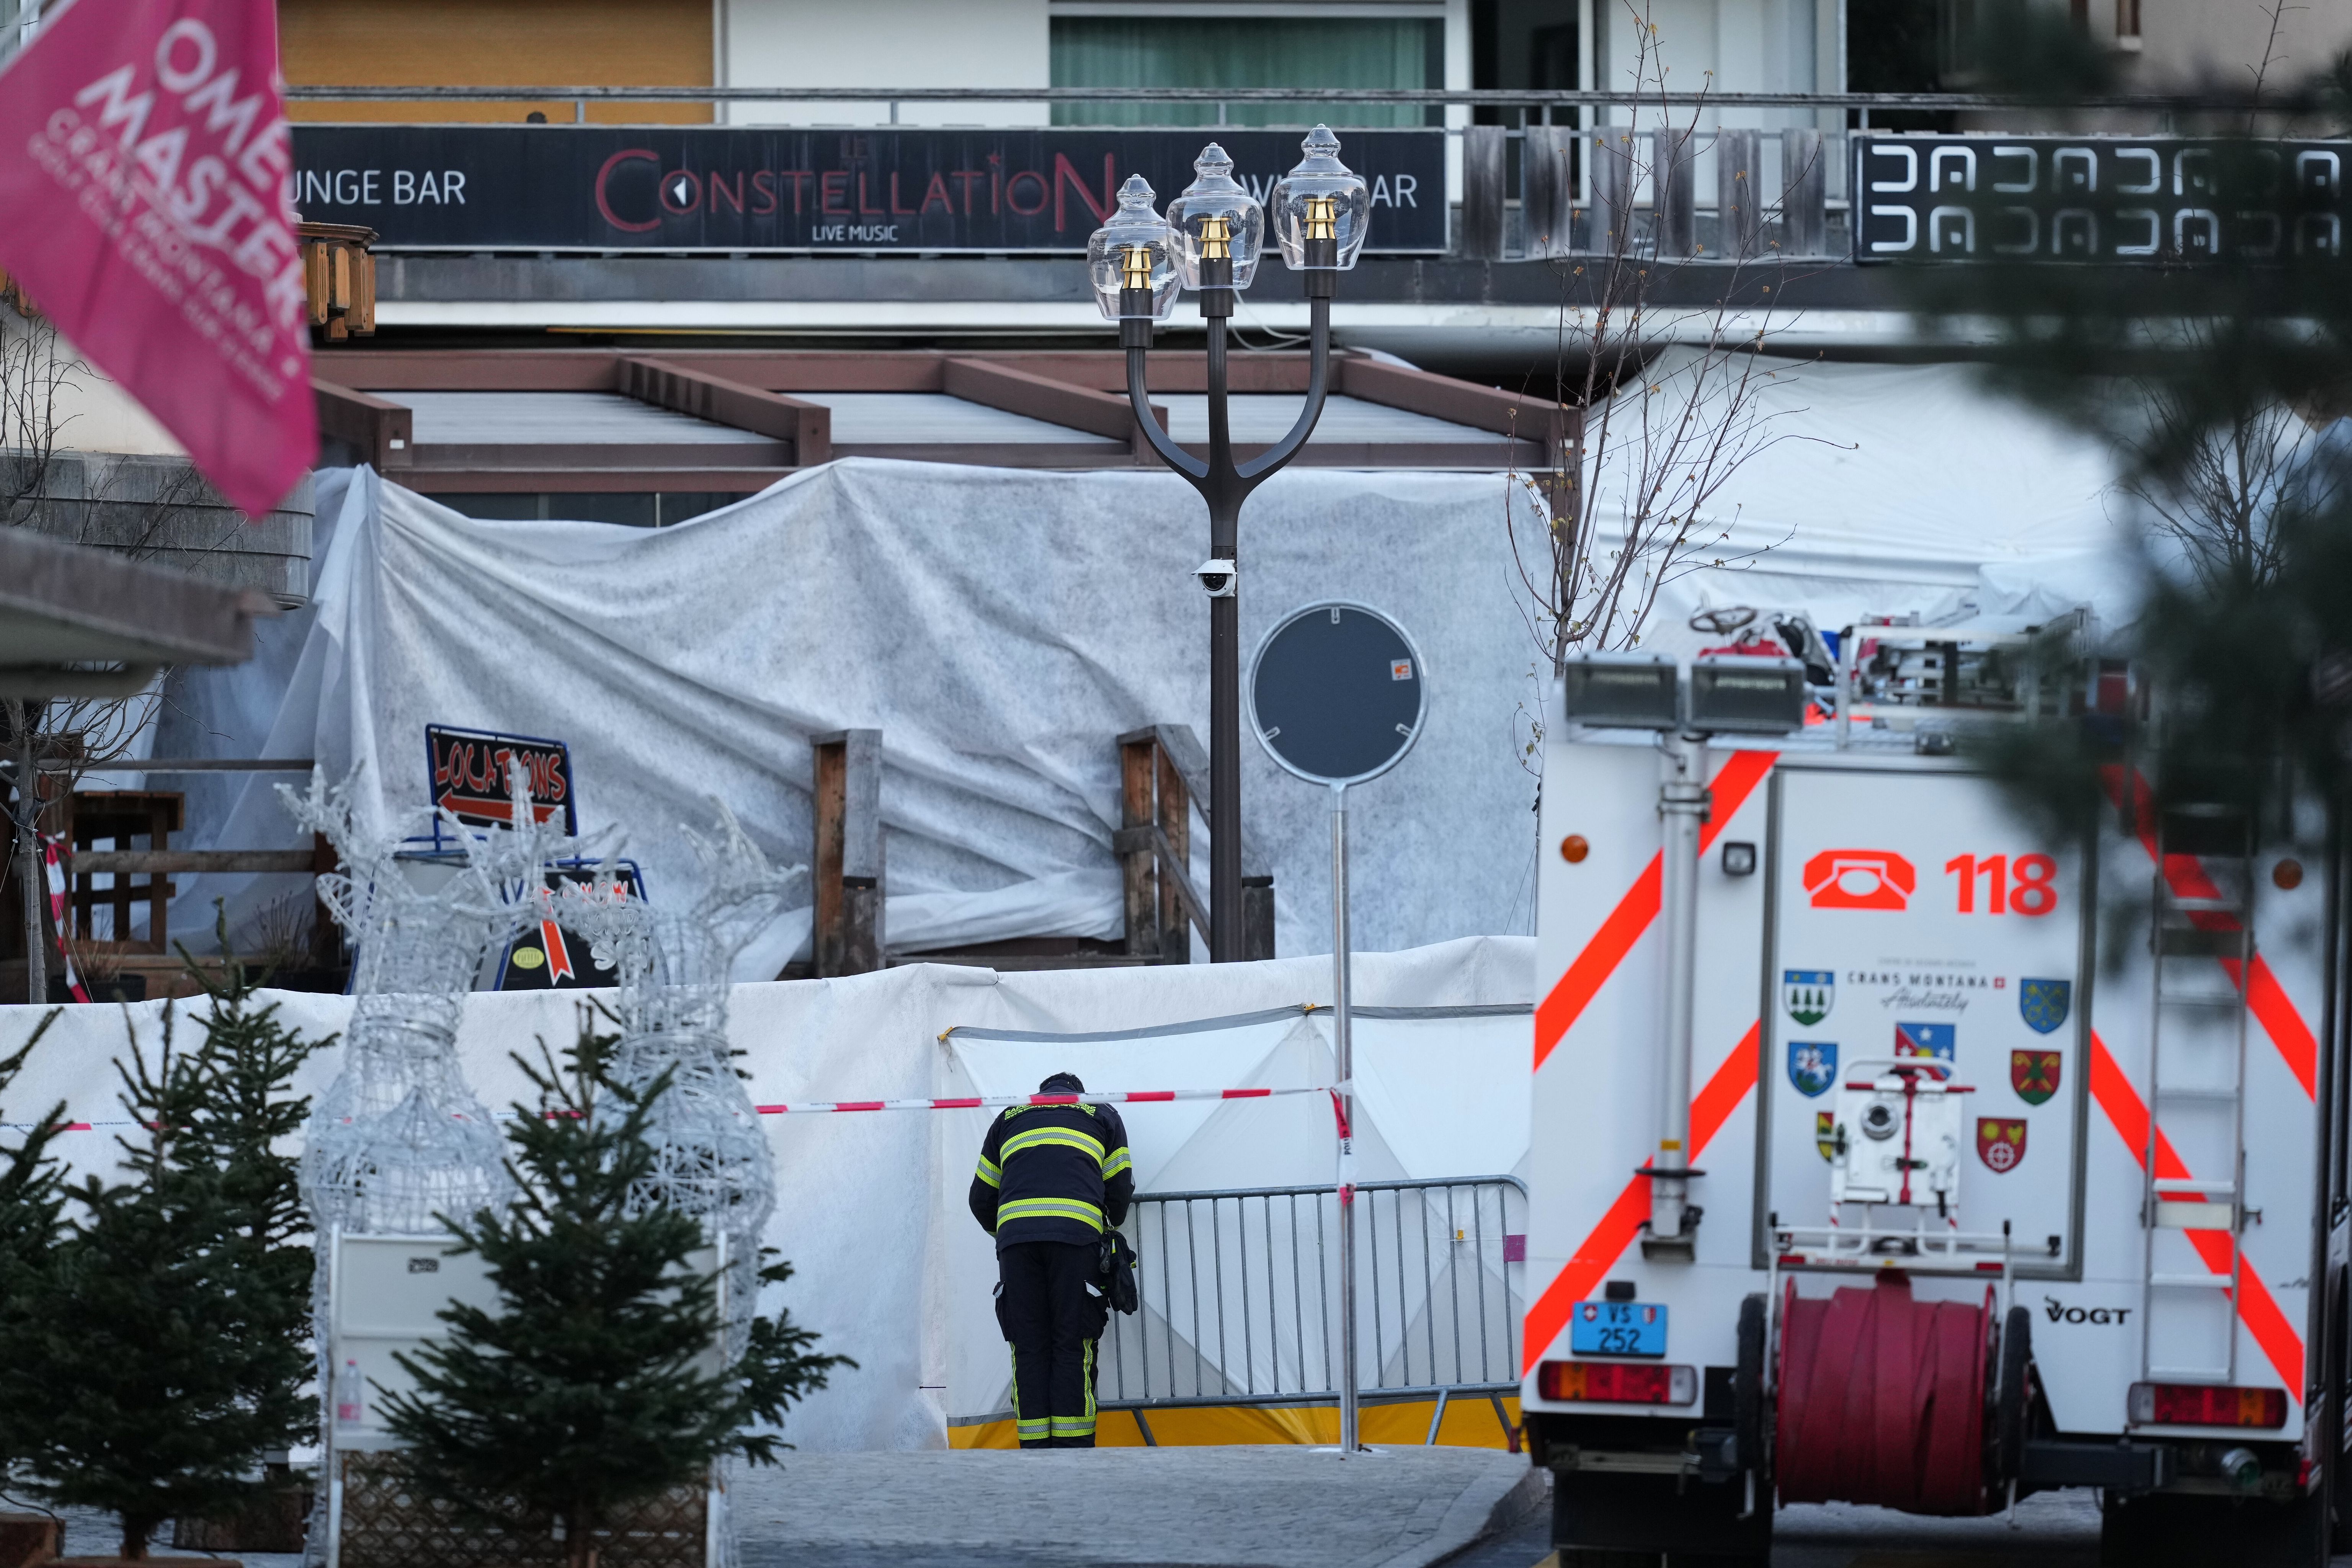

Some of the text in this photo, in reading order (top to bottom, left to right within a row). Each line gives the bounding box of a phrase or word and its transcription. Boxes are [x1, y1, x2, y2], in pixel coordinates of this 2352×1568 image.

[288, 170, 466, 205] UNGE BAR
[812, 225, 898, 242] LIVE MUSIC
[1945, 853, 2058, 916] 118
[1847, 970, 1988, 989] CRANS MONTANA
[1610, 1305, 1632, 1324] VS
[2045, 1301, 2132, 1325] VOGT
[1598, 1328, 1642, 1352] 252
